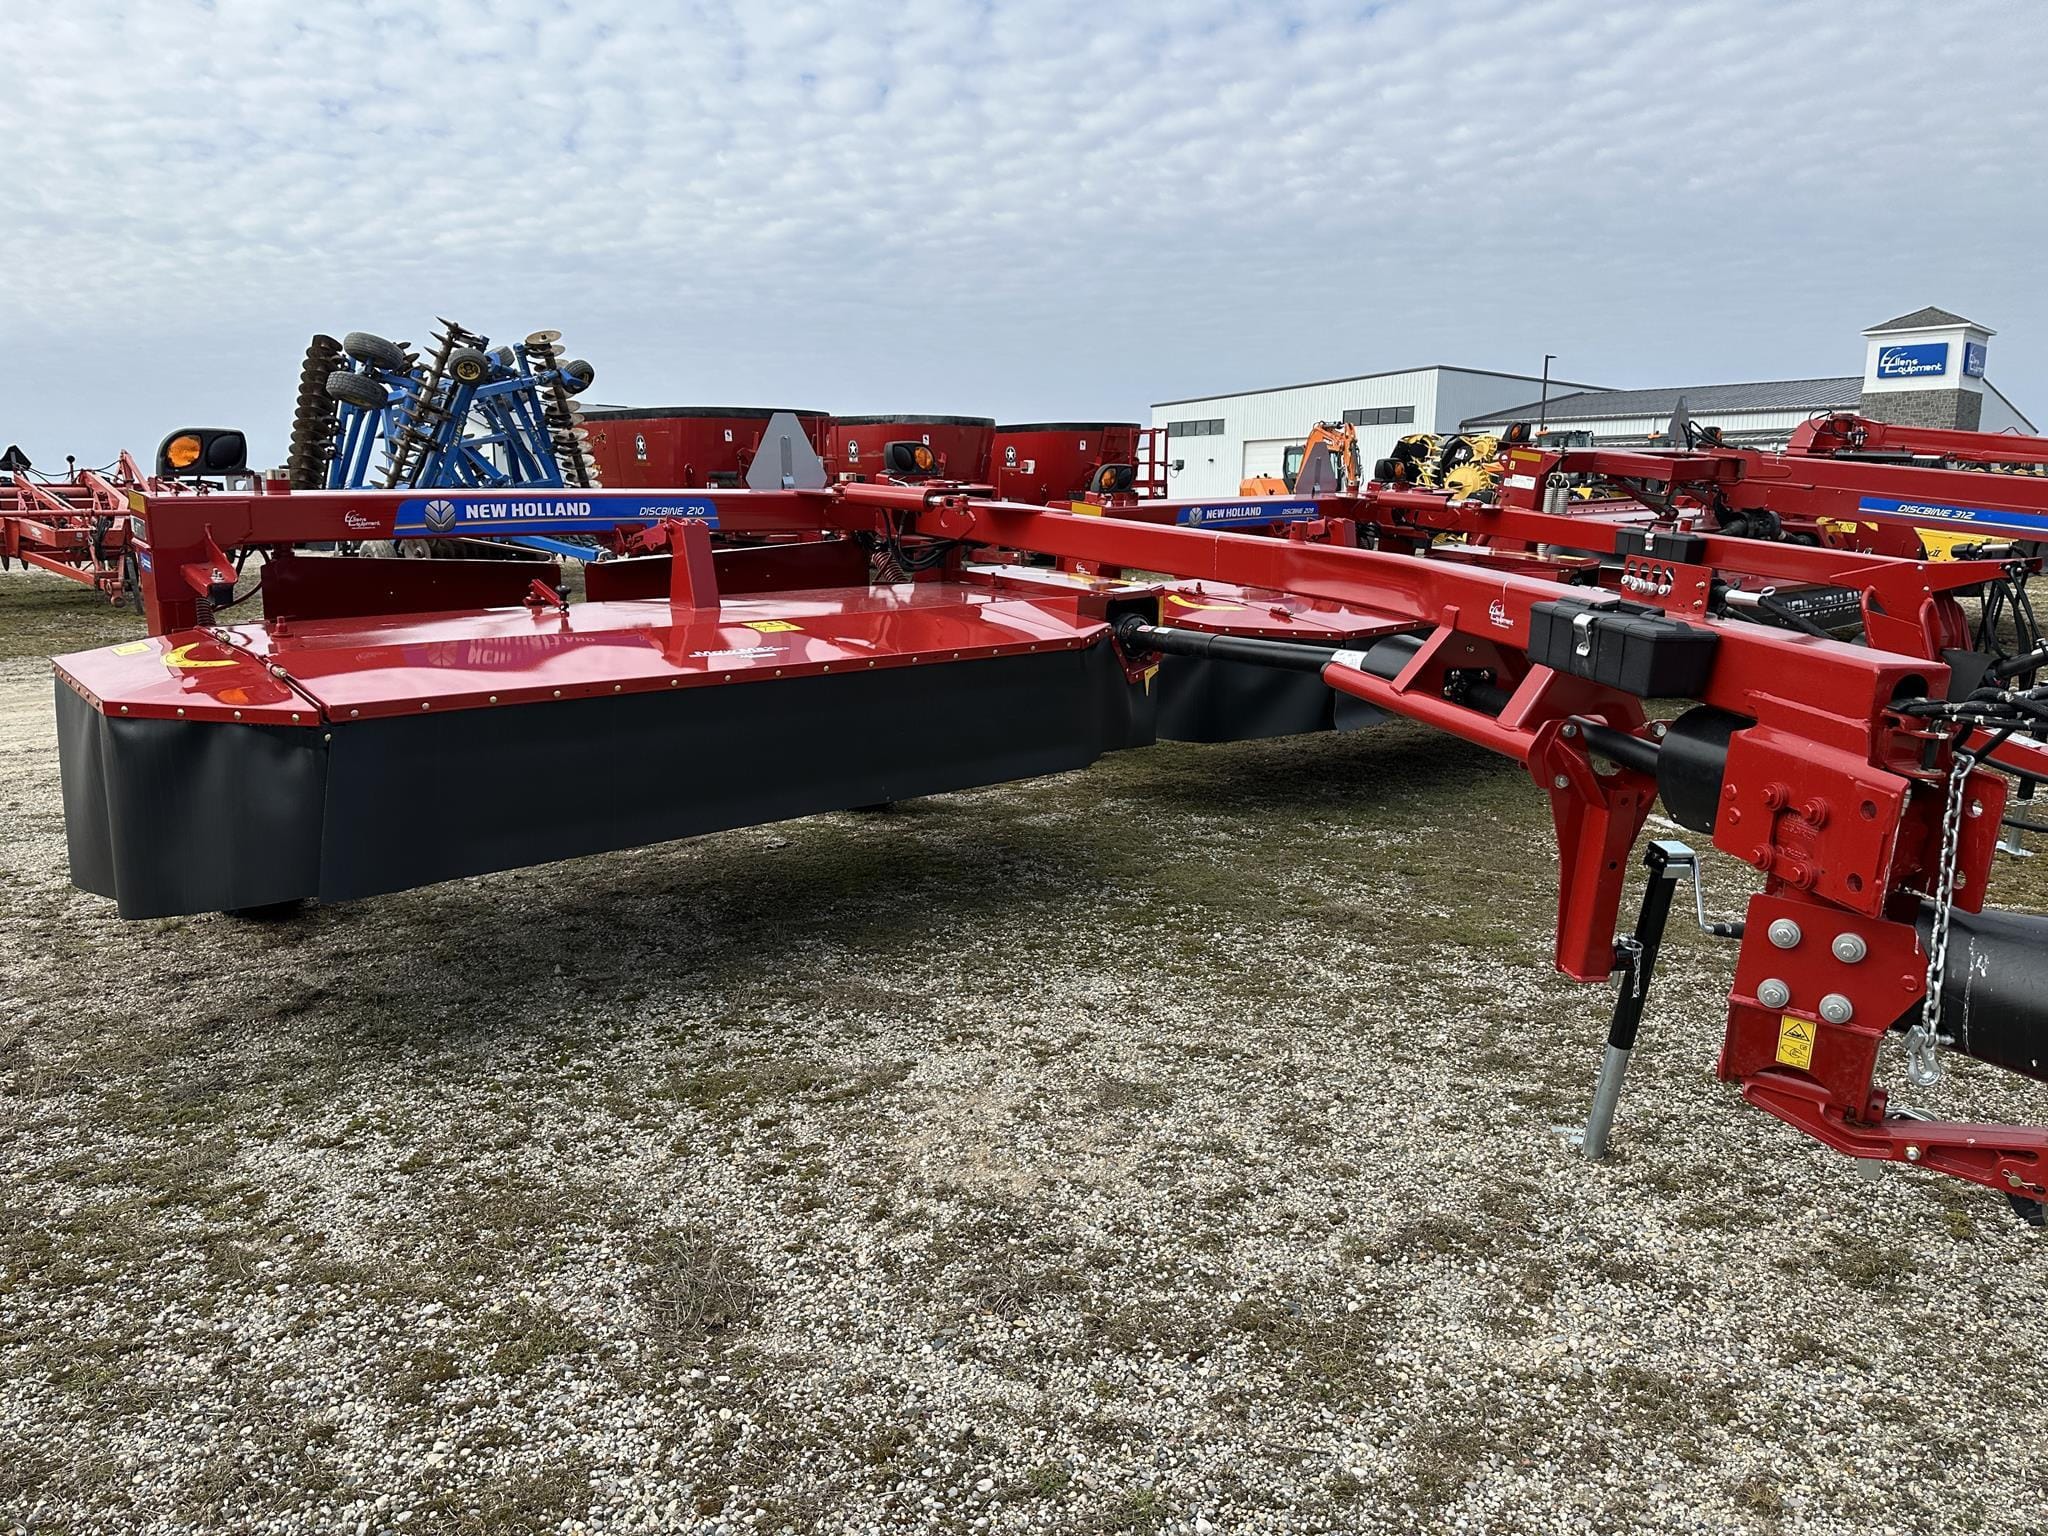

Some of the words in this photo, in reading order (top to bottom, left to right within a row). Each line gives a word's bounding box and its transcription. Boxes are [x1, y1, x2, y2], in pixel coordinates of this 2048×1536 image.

[1880, 347, 1918, 367] Ellens
[1885, 352, 1942, 374] Equipment
[466, 503, 507, 519] NEW
[511, 502, 592, 518] HOLLAND
[639, 506, 684, 516] DISCBINE
[686, 506, 705, 516] 210
[1206, 508, 1225, 519] NEW
[1226, 506, 1262, 518] HOLLAND
[1897, 504, 1953, 517] DISCBINE
[1951, 510, 1976, 520] 312
